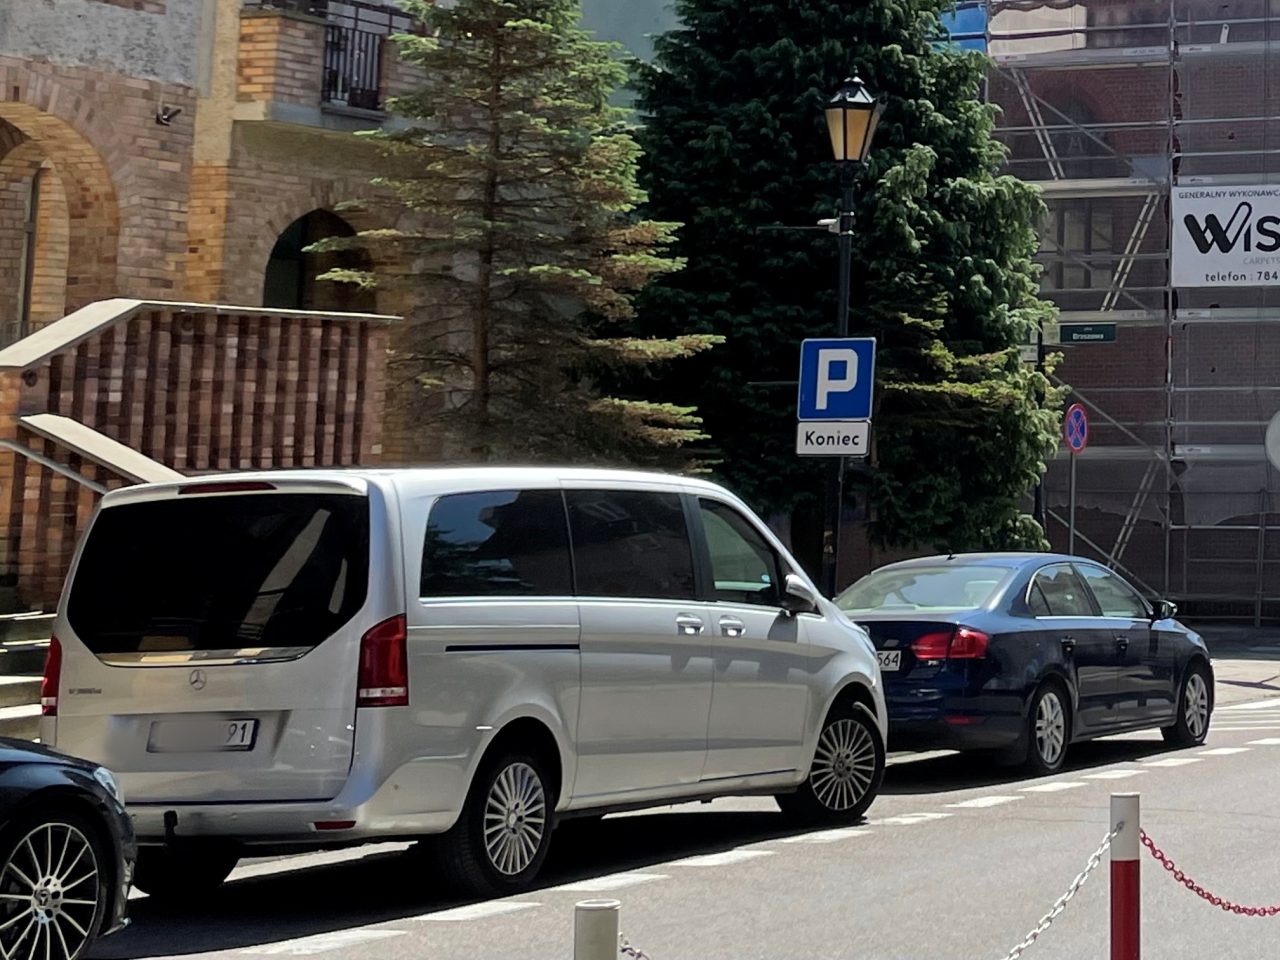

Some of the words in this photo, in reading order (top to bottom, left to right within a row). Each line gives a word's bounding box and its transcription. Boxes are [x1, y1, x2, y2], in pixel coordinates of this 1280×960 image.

[1178, 190, 1227, 199] GENERALNY
[1242, 256, 1280, 265] CARPETS
[1205, 271, 1247, 282] telefon
[1256, 270, 1279, 281] 784
[815, 348, 859, 410] P
[805, 430, 860, 446] Koniec
